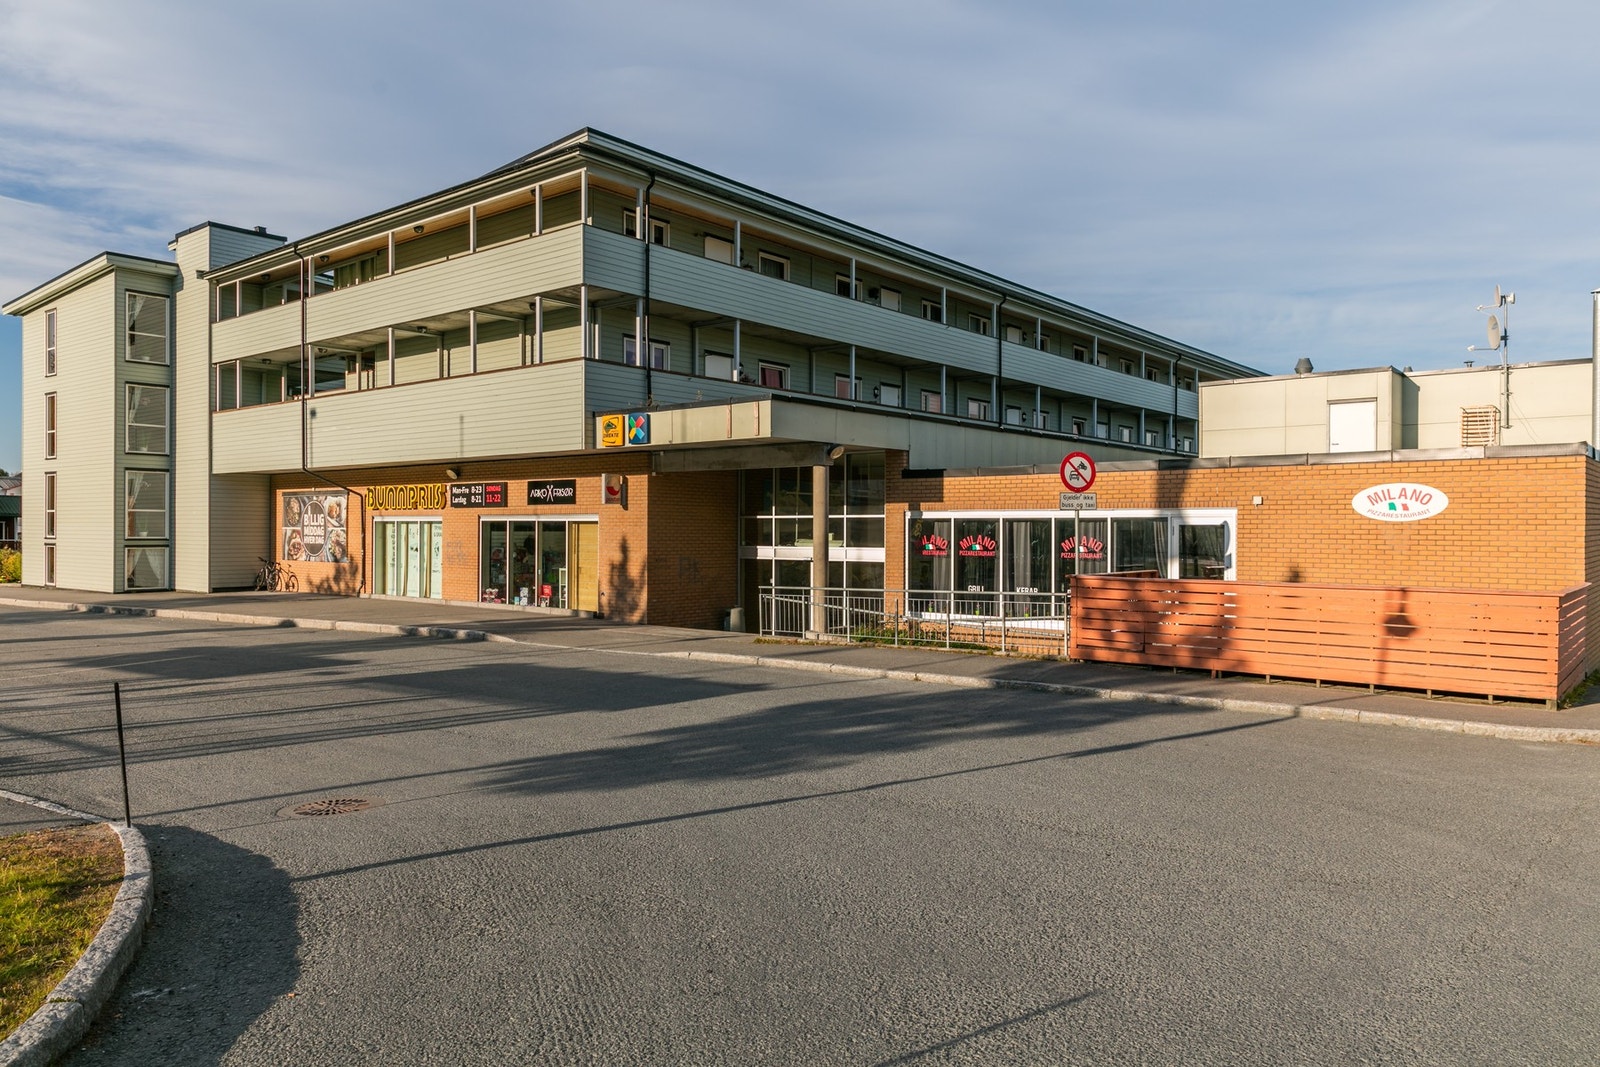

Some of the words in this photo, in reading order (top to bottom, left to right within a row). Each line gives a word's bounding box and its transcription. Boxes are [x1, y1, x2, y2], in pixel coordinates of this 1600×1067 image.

[367, 484, 445, 510] BUNNPRIS
[471, 485, 482, 494] 8-23
[1367, 487, 1433, 506] MILANO
[471, 495, 481, 503] 8-21
[959, 534, 996, 550] MILANO
